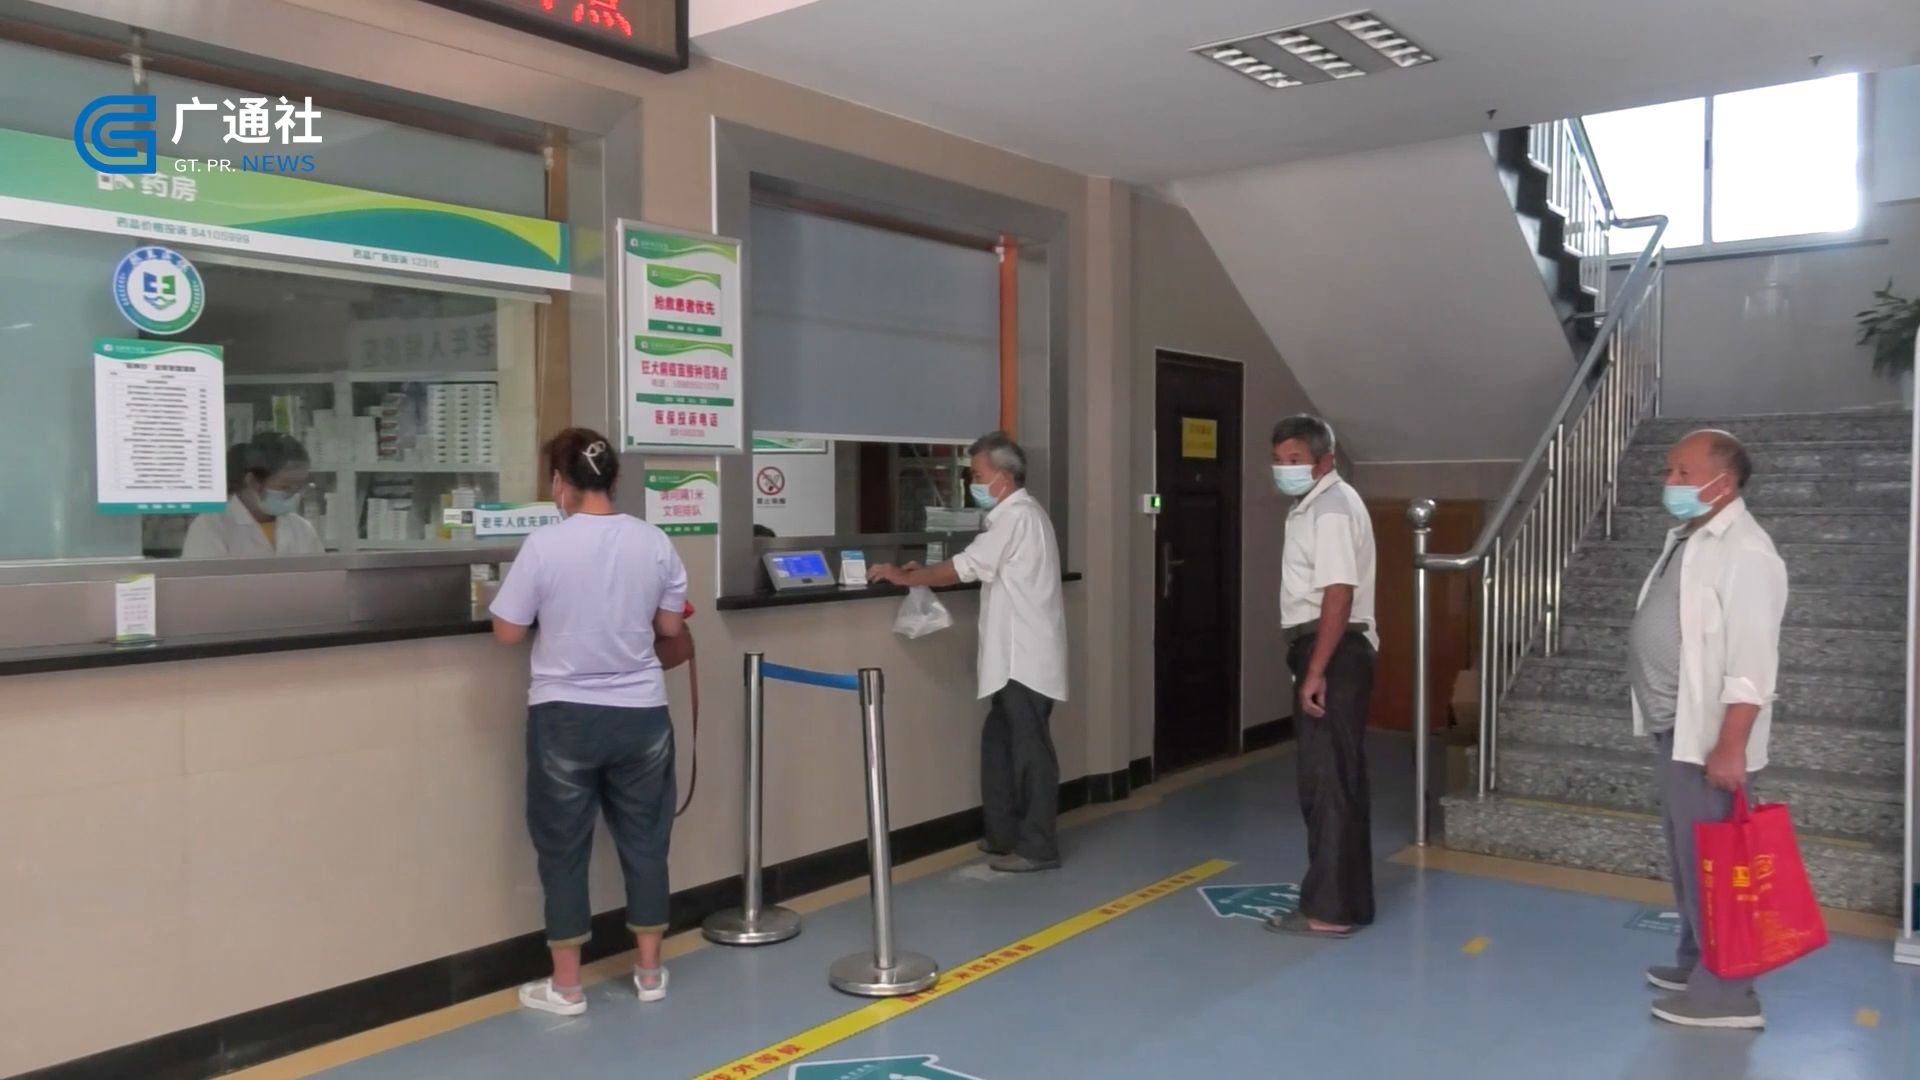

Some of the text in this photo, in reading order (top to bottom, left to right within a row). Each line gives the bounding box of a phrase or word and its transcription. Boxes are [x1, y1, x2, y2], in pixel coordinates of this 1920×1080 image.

[655, 410, 719, 427] 医保投诉电话
